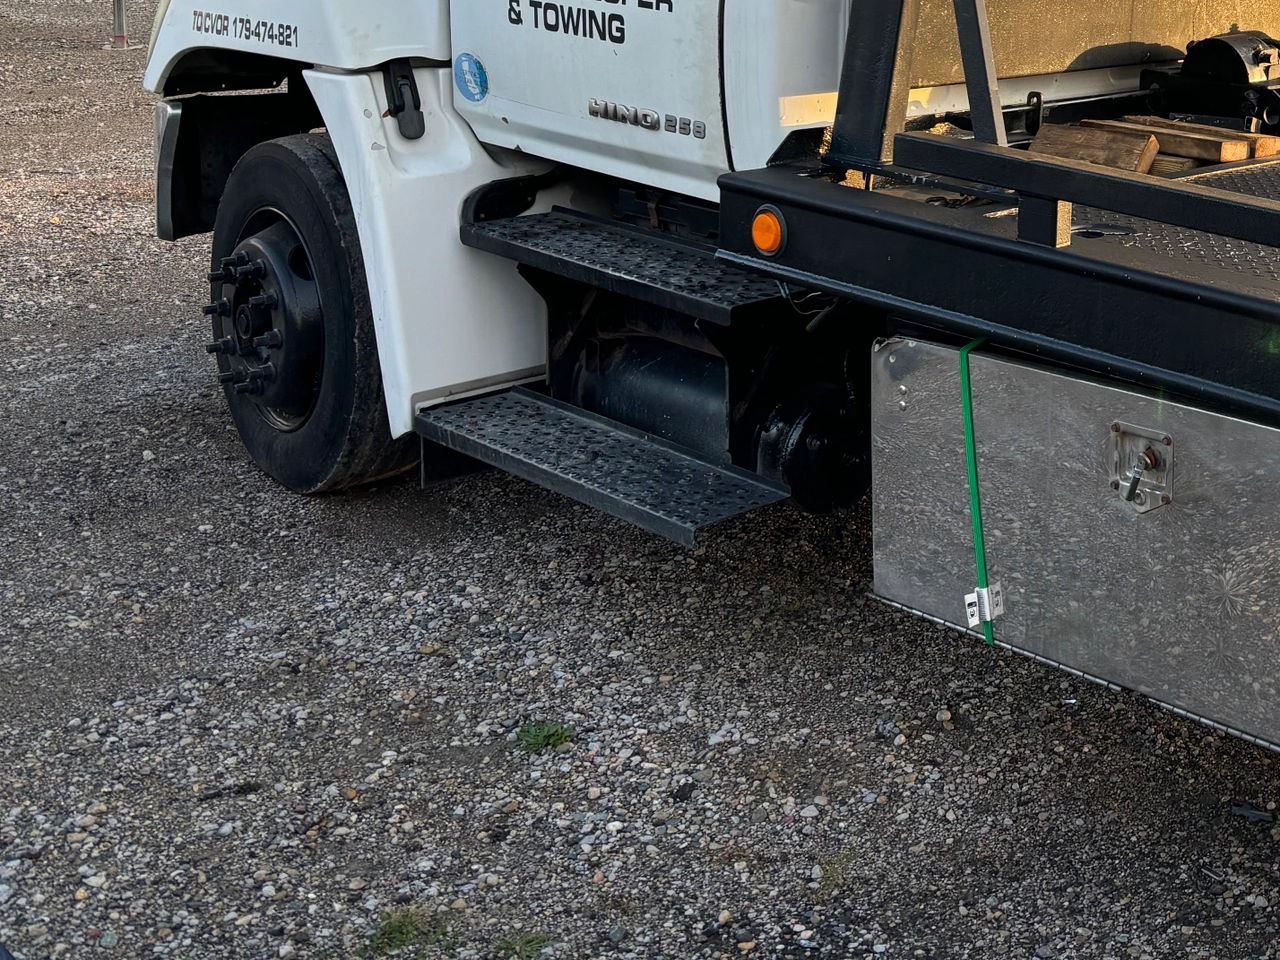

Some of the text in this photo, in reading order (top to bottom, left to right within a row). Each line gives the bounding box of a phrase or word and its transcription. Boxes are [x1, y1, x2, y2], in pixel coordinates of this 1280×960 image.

[203, 11, 230, 37] CVOR
[232, 16, 299, 48] 179-474-821
[529, 0, 626, 45] TOWING
[588, 97, 707, 140] HINO 258
